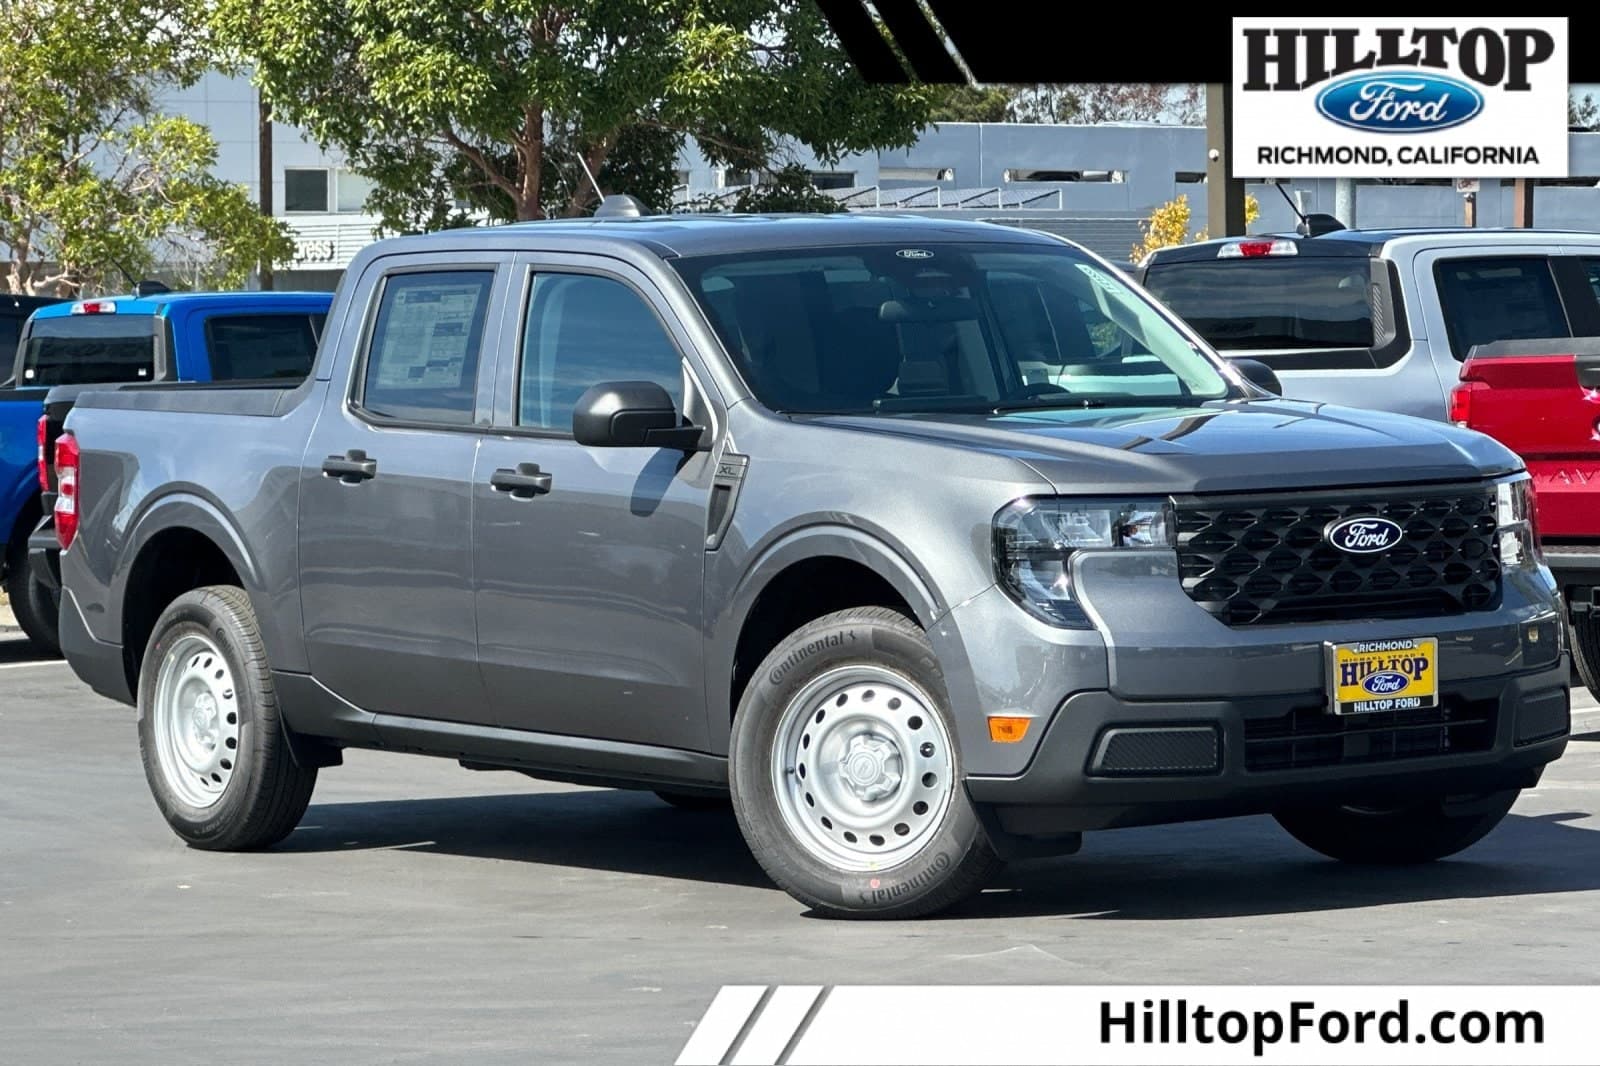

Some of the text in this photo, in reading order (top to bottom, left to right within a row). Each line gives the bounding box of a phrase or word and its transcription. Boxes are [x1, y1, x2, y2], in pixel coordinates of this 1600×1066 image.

[719, 465, 737, 476] XL
[1344, 522, 1389, 548] Ford
[1359, 640, 1413, 653] RICHMOND
[768, 630, 846, 686] Continental
[1340, 657, 1429, 687] HILLTOP
[1371, 674, 1401, 692] Ford
[1353, 697, 1421, 713] HILLTOP FORD
